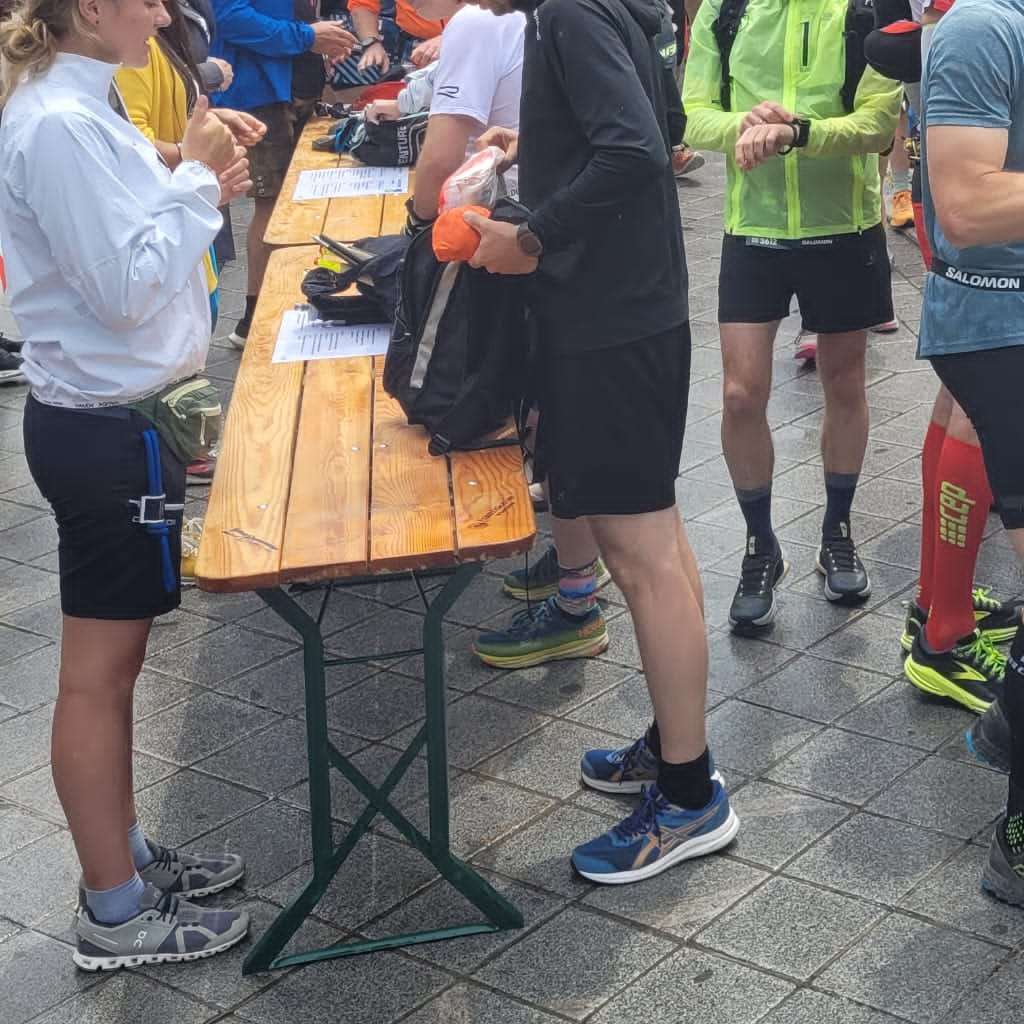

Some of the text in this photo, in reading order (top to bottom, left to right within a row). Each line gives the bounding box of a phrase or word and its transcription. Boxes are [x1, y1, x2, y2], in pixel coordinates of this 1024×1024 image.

[397, 125, 409, 165] ENTURE
[945, 266, 1021, 289] SALOMON
[939, 480, 977, 526] cep
